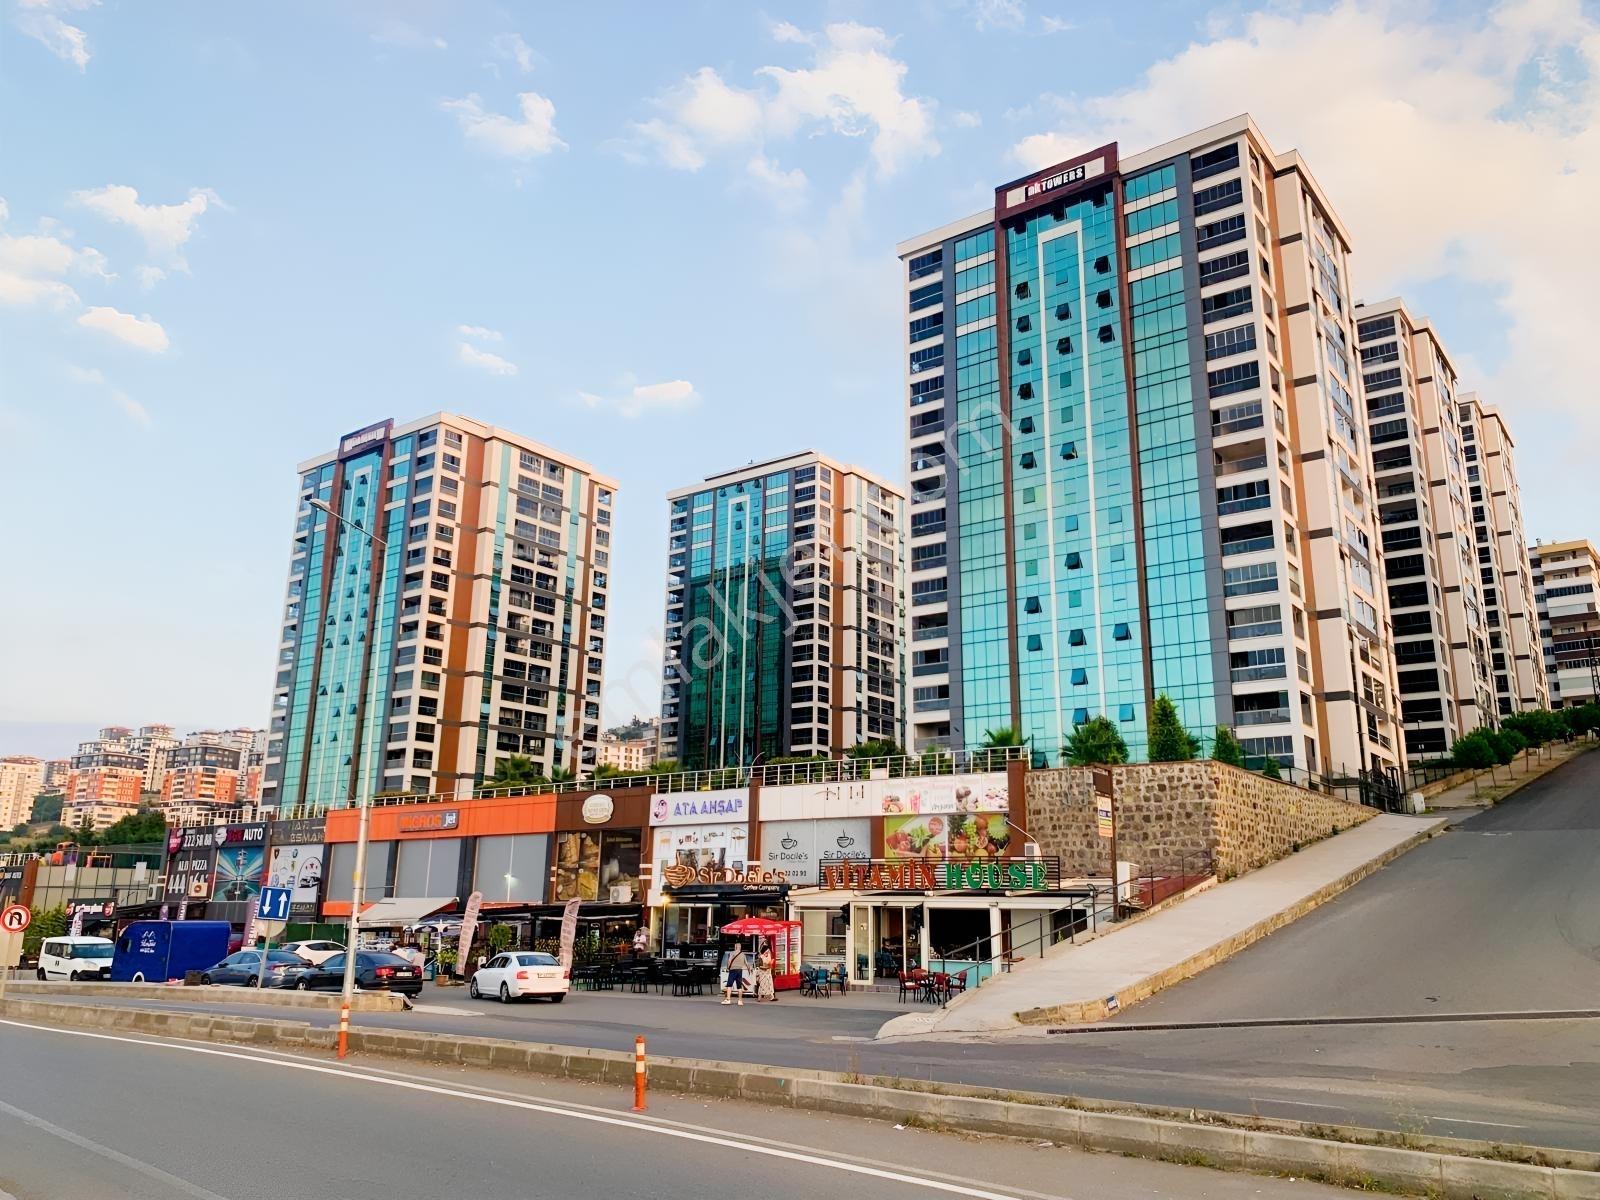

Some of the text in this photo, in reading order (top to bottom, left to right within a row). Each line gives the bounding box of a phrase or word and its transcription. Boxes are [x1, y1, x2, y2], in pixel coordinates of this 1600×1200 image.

[1041, 168, 1084, 191] TOWERS
[674, 799, 743, 816] ATA AHŞAP
[243, 827, 264, 841] AUTO
[768, 852, 779, 861] Sir
[823, 850, 834, 859] Sir
[191, 859, 208, 871] PIZZA
[167, 873, 186, 894] 444
[698, 866, 721, 884] Sir
[944, 861, 1049, 891] HOUSE
